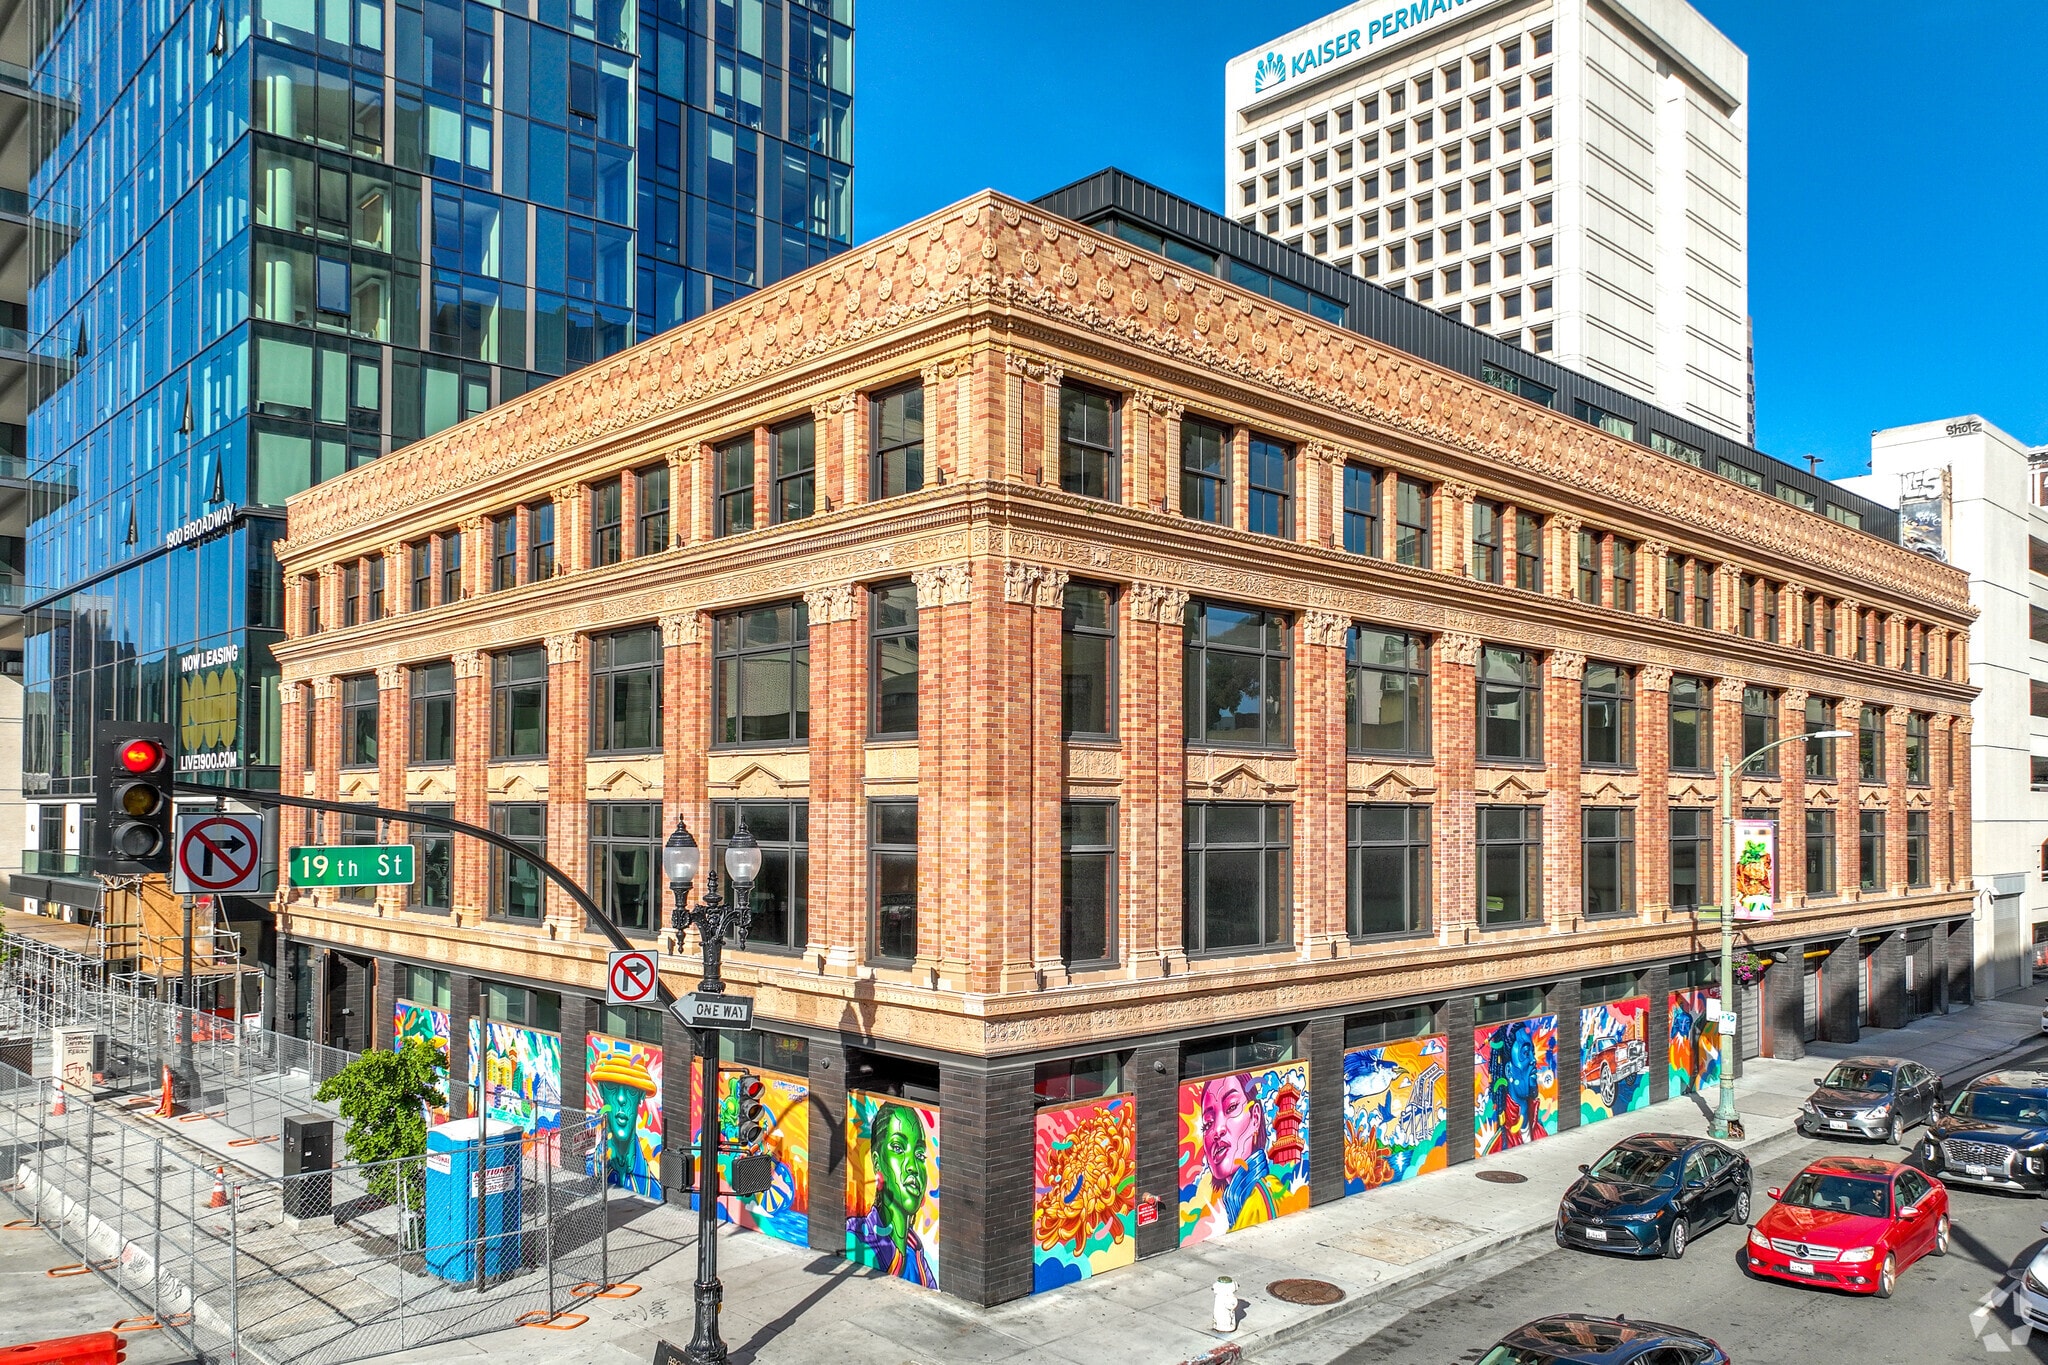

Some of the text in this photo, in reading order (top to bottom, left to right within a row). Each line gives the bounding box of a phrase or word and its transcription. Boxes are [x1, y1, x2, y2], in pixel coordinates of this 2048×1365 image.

[1291, 29, 1361, 77] KAISER
[166, 503, 237, 549] 1900 BROADWAY
[181, 645, 239, 672] NOW LEASING
[180, 752, 237, 771] LIVE1900.COM
[377, 854, 402, 876] St
[696, 1003, 744, 1019] ONE WAY
[474, 1164, 515, 1178] NTIONAL
